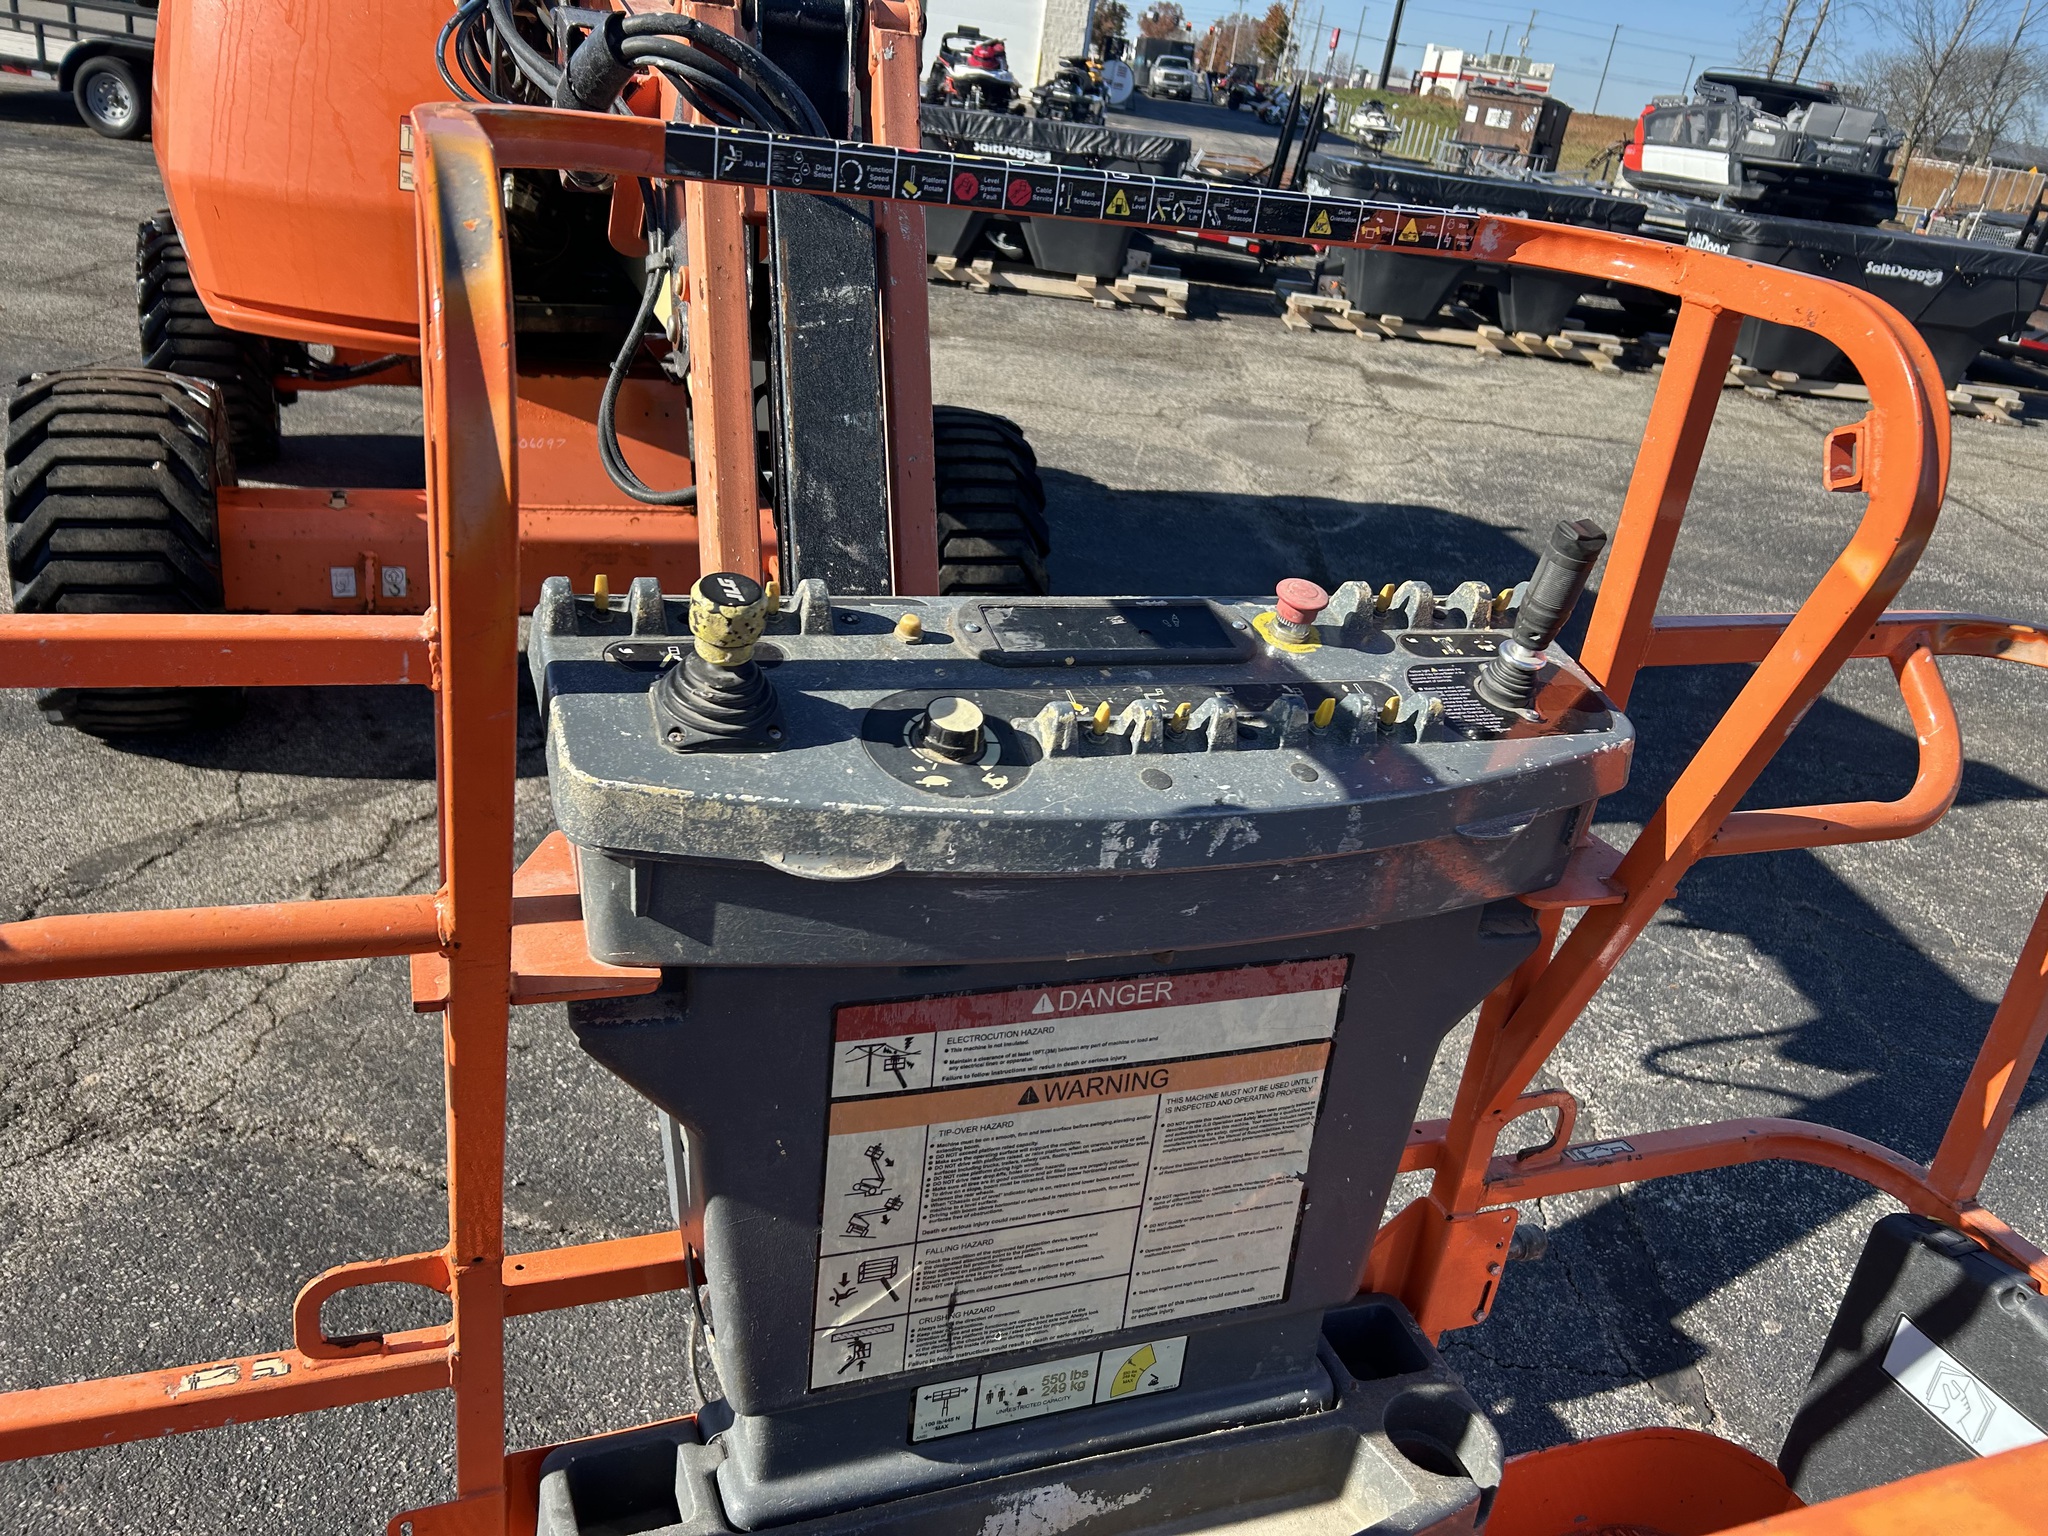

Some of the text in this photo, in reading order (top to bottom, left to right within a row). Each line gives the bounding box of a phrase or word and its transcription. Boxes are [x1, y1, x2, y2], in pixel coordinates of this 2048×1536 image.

[755, 161, 766, 169] Lift
[815, 164, 832, 172] Drive
[866, 165, 893, 174] Function
[813, 170, 833, 179] Select
[869, 173, 889, 183] Speed
[921, 176, 947, 185] Platform
[983, 176, 999, 184] Level
[867, 182, 890, 191] Control
[923, 184, 943, 193] Rotate
[980, 184, 1001, 193] System
[1036, 186, 1052, 194] Cable
[982, 192, 997, 200] Fault
[1032, 194, 1053, 202] Service
[1081, 190, 1095, 198] Main
[1073, 197, 1101, 207] Telescope
[1131, 203, 1146, 211] Level
[1186, 207, 1202, 215] Tower
[1226, 214, 1252, 223] Telescope
[1330, 216, 1357, 224] Orientation
[1058, 979, 1173, 1012] DANGER
[946, 1025, 1055, 1045] ELECTROCUTION HAZARD
[1003, 1039, 1029, 1047] insulated.
[941, 1073, 963, 1081] Failure
[971, 1070, 990, 1078] follow
[990, 1066, 1026, 1076] instructions
[1109, 1054, 1127, 1062] injury.
[1042, 1067, 1170, 1103] WARNING
[1165, 1096, 1184, 1105] THIS
[1184, 1091, 1219, 1103] MACHINE
[1220, 1088, 1241, 1098] MUST
[1242, 1085, 1258, 1094] NOT
[1258, 1084, 1268, 1092] BE
[1269, 1080, 1290, 1090] USED
[1290, 1077, 1310, 1087] UNTIL
[1164, 1084, 1313, 1114] IS INSPECTED AND OPERATING PROPERLY
[938, 1120, 1014, 1137] TIP-OVER HAZARD
[921, 1227, 940, 1235] Death
[948, 1223, 972, 1231] serious
[972, 1219, 990, 1228] injury
[925, 1238, 994, 1255] FALLING HAZARD
[914, 1295, 933, 1304] Falling
[934, 1292, 949, 1300] from
[975, 1284, 993, 1293] could
[1012, 1278, 1029, 1286] death
[1036, 1273, 1058, 1281] serious
[1059, 1270, 1076, 1278] injury.
[962, 1305, 995, 1317] HAZARD
[936, 1352, 955, 1362] follow
[955, 1347, 990, 1358] instructions
[990, 1343, 1007, 1352] could
[1008, 1340, 1024, 1348] result
[1032, 1336, 1048, 1344] death
[1056, 1330, 1077, 1339] serious
[1041, 1368, 1089, 1387] 550 lbs
[1041, 1380, 1086, 1397] 249 kg
[995, 1395, 1071, 1415] UNRESTRICTED CAPACITY
[925, 1420, 937, 1428] 100
[934, 1423, 949, 1431] MAX
